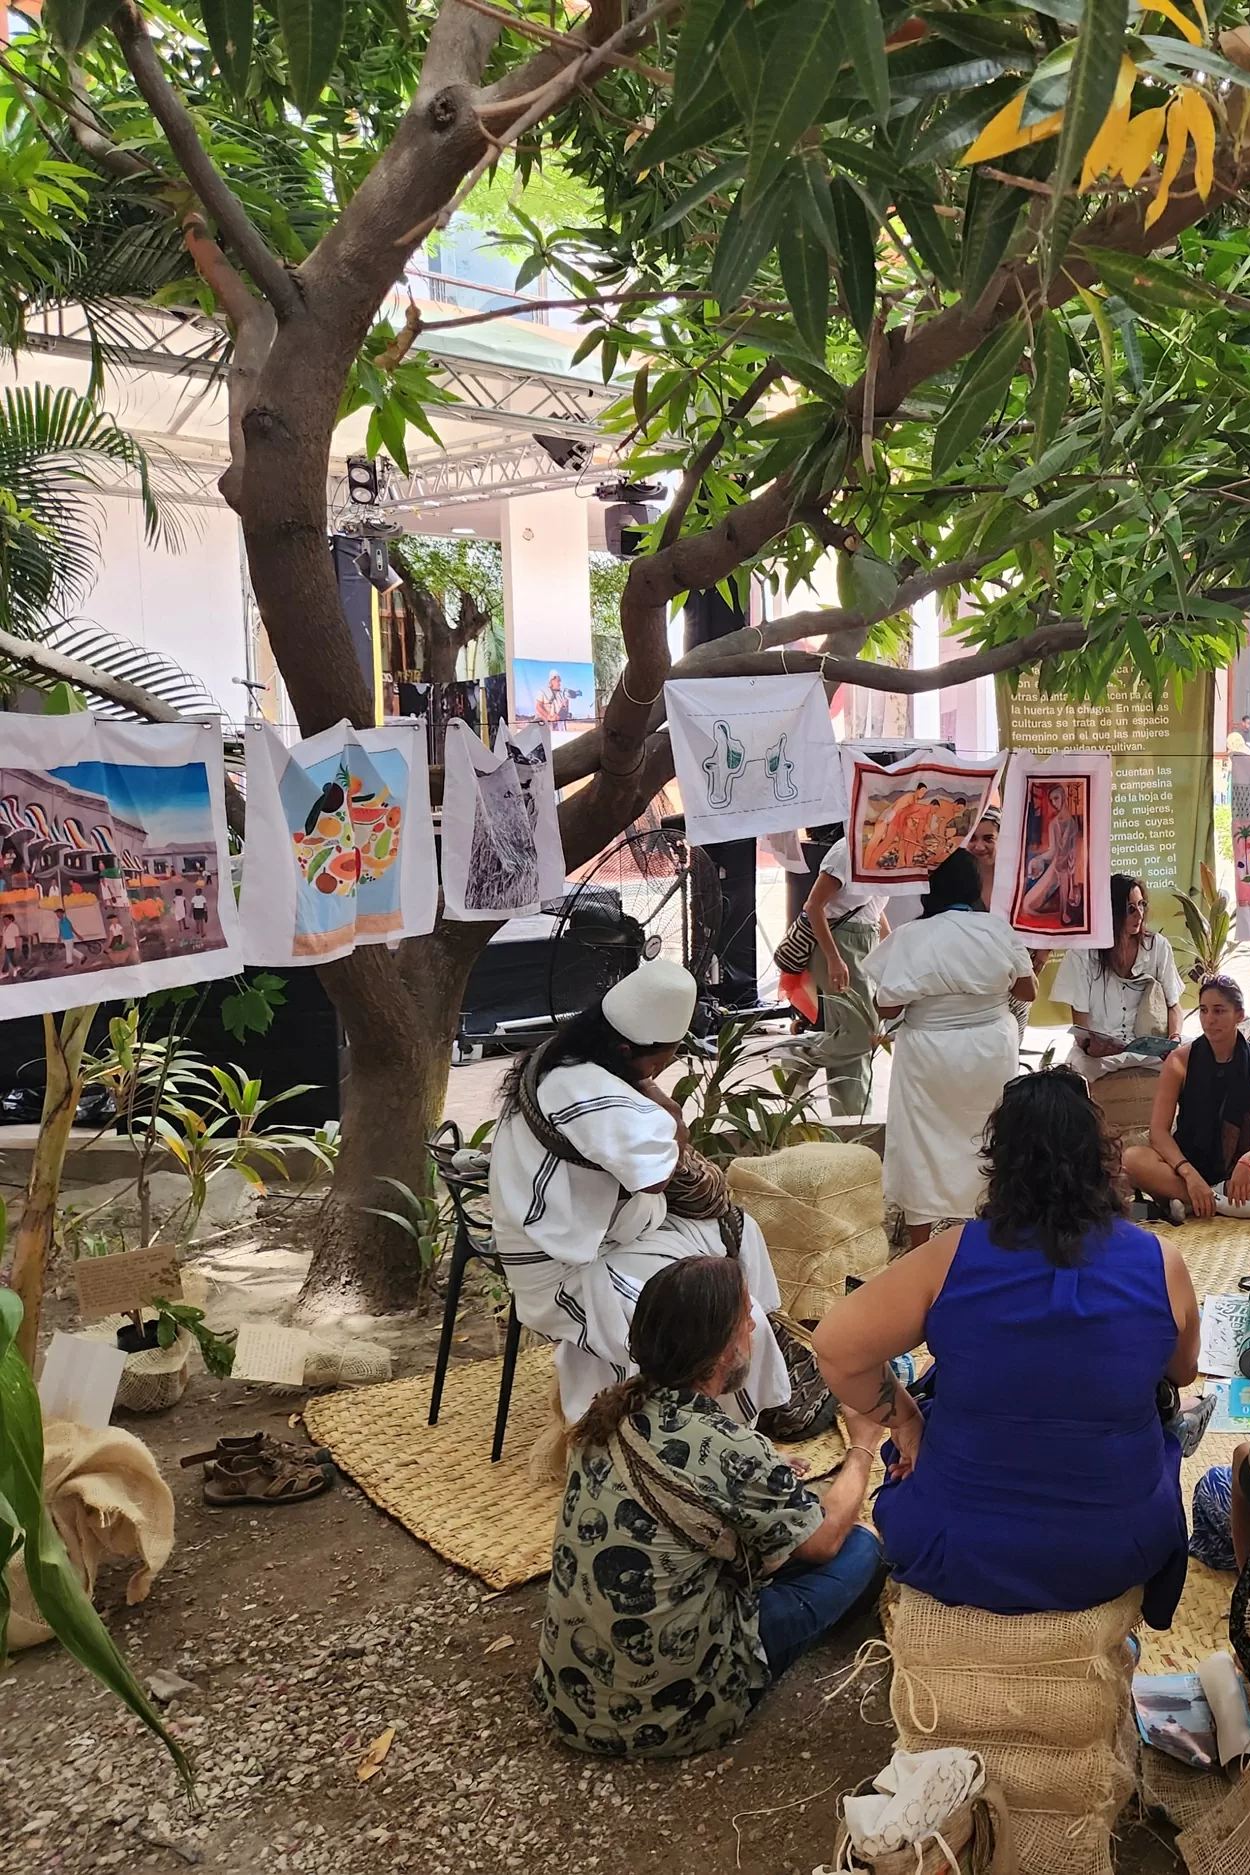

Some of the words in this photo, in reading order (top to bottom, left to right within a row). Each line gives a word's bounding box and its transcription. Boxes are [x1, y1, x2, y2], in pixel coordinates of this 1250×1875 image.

[1011, 704, 1021, 714] la
[1023, 705, 1055, 715] huerta
[1057, 706, 1064, 716] y
[1065, 704, 1075, 714] la
[1116, 703, 1130, 713] En
[1011, 719, 1053, 728] culturas
[1056, 720, 1069, 728] se
[1073, 719, 1096, 728] trata
[1100, 717, 1112, 726] de
[1115, 718, 1129, 726] un
[1132, 715, 1169, 727] espacio
[1011, 731, 1058, 741] femenino
[1062, 732, 1075, 740] en
[1079, 730, 1089, 740] el
[1092, 731, 1111, 741] que
[1113, 729, 1129, 739] las
[1132, 728, 1170, 740] mujeres
[1105, 741, 1146, 752] cultivan.
[1115, 767, 1154, 777] cuentan
[1157, 765, 1172, 775] las
[1120, 779, 1172, 792] campesina
[1114, 793, 1127, 803] de
[1128, 793, 1138, 802] la
[1138, 792, 1159, 803] hoja
[1160, 791, 1173, 800] de
[1112, 806, 1125, 815] de
[1132, 804, 1174, 816] mujeres,
[1113, 818, 1140, 828] niños
[1145, 817, 1175, 828] cuyas
[1109, 832, 1148, 842] ormado,
[1149, 829, 1176, 839] tanto
[1111, 843, 1155, 855] ejercidas
[1159, 842, 1177, 852] por
[1111, 857, 1138, 866] como
[1144, 856, 1161, 866] por
[1167, 853, 1177, 862] el
[1147, 866, 1177, 875] social
